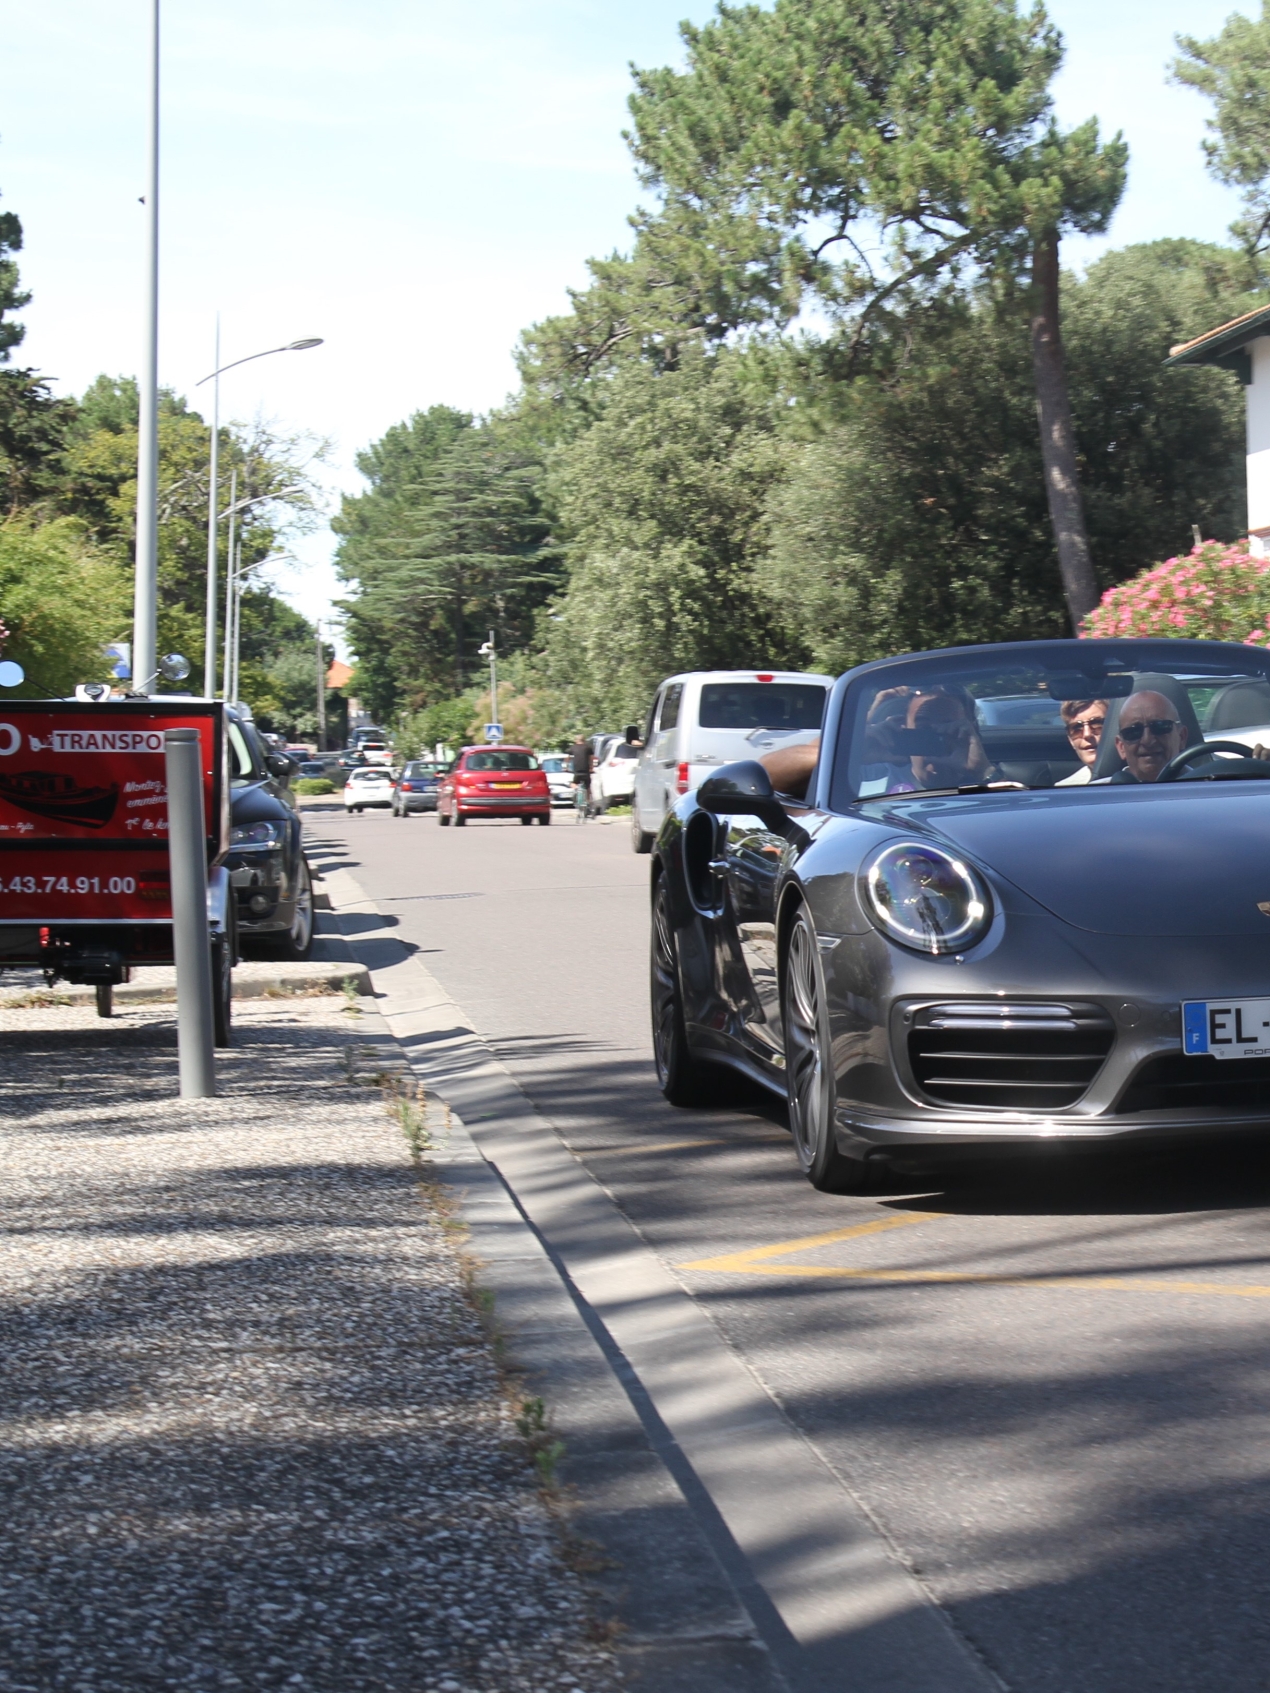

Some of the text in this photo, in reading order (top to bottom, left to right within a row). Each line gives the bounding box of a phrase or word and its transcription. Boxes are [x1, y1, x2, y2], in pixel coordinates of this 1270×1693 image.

[56, 733, 161, 751] TRANSPO
[0, 876, 136, 894] .43.74.91.00
[1192, 1033, 1200, 1044] F
